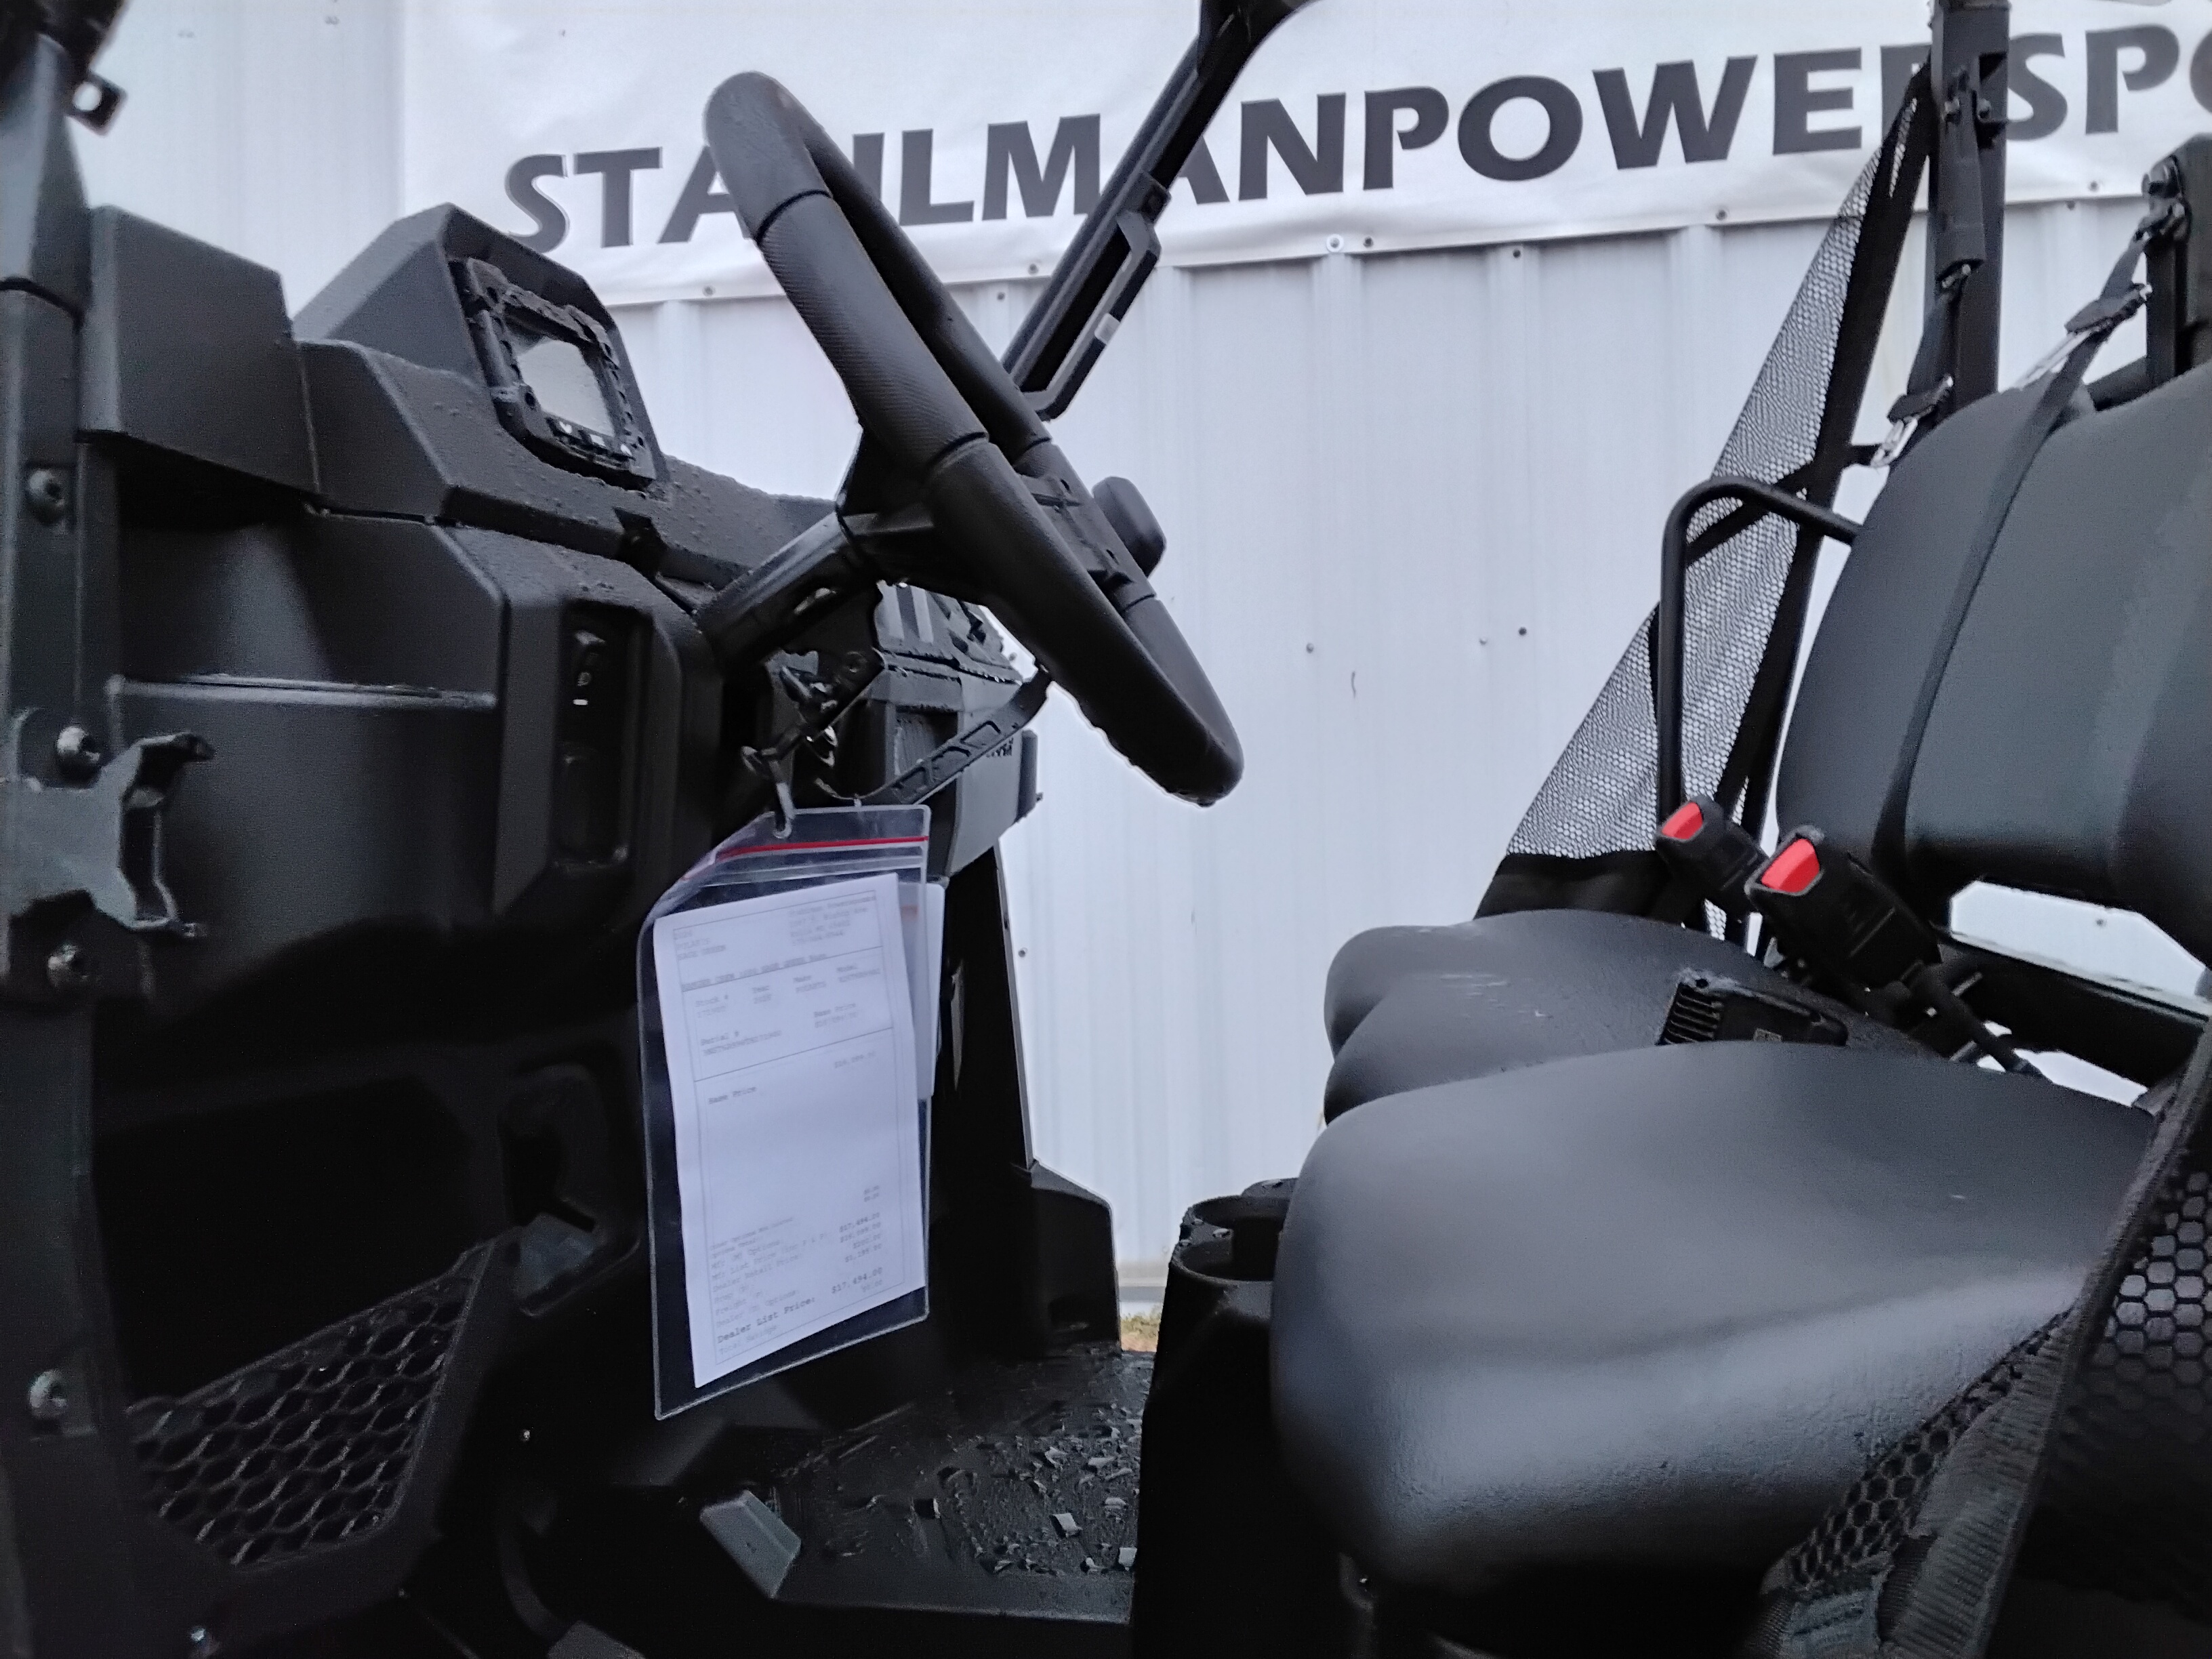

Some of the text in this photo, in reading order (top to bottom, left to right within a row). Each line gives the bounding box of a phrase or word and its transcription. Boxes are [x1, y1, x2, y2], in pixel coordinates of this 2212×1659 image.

[832, 1266, 882, 1294] $17,494.00
[717, 1294, 815, 1344] Dealer List Price:
